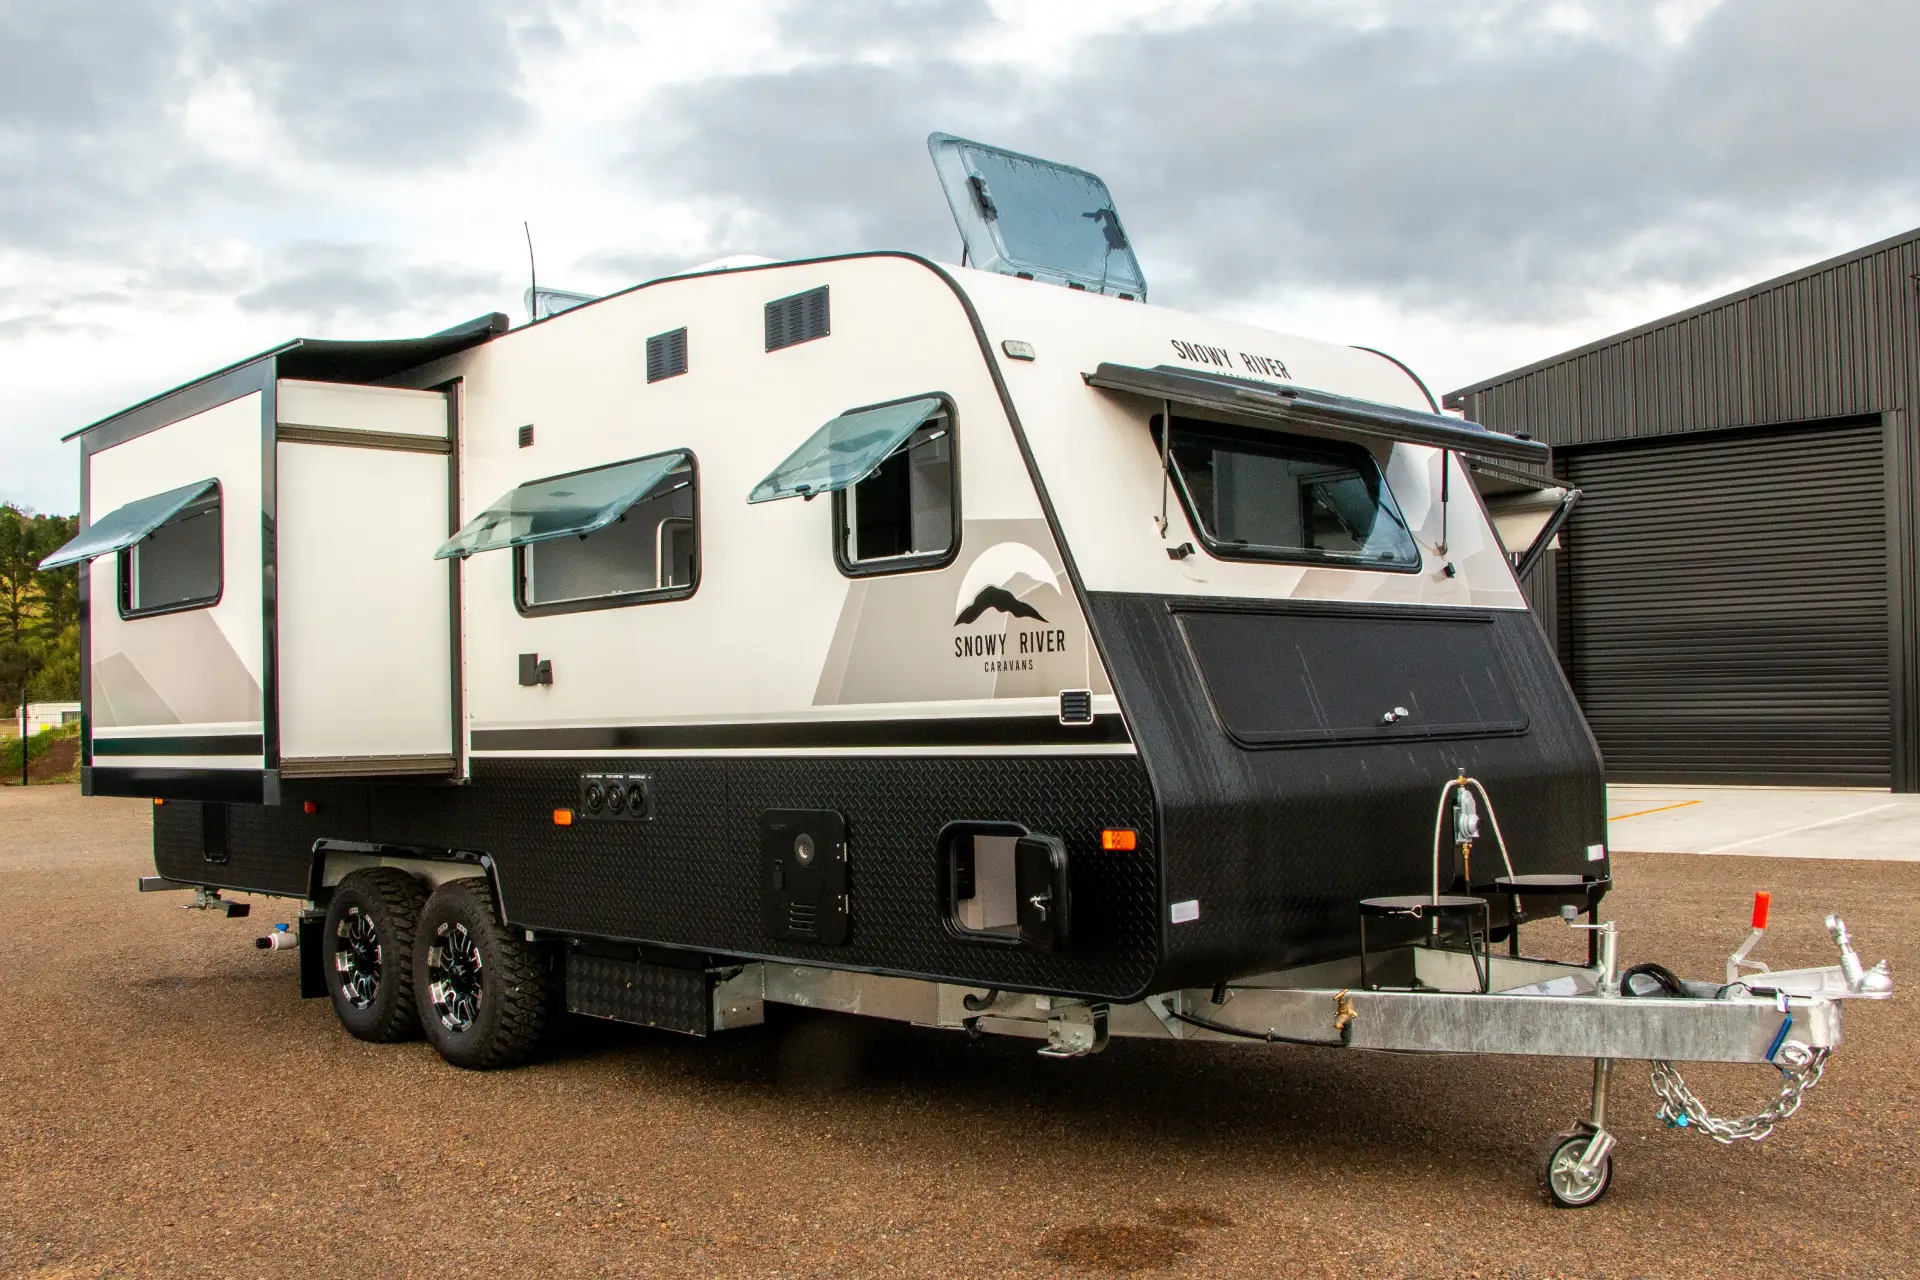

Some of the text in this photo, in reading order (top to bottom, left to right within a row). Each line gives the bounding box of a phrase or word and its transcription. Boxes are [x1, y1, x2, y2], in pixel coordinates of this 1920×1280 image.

[1171, 339, 1233, 368] SNOWY
[1239, 352, 1292, 379] RIVER
[955, 630, 1065, 657] SNOWY RIVER
[984, 659, 1033, 672] CARAVANS
